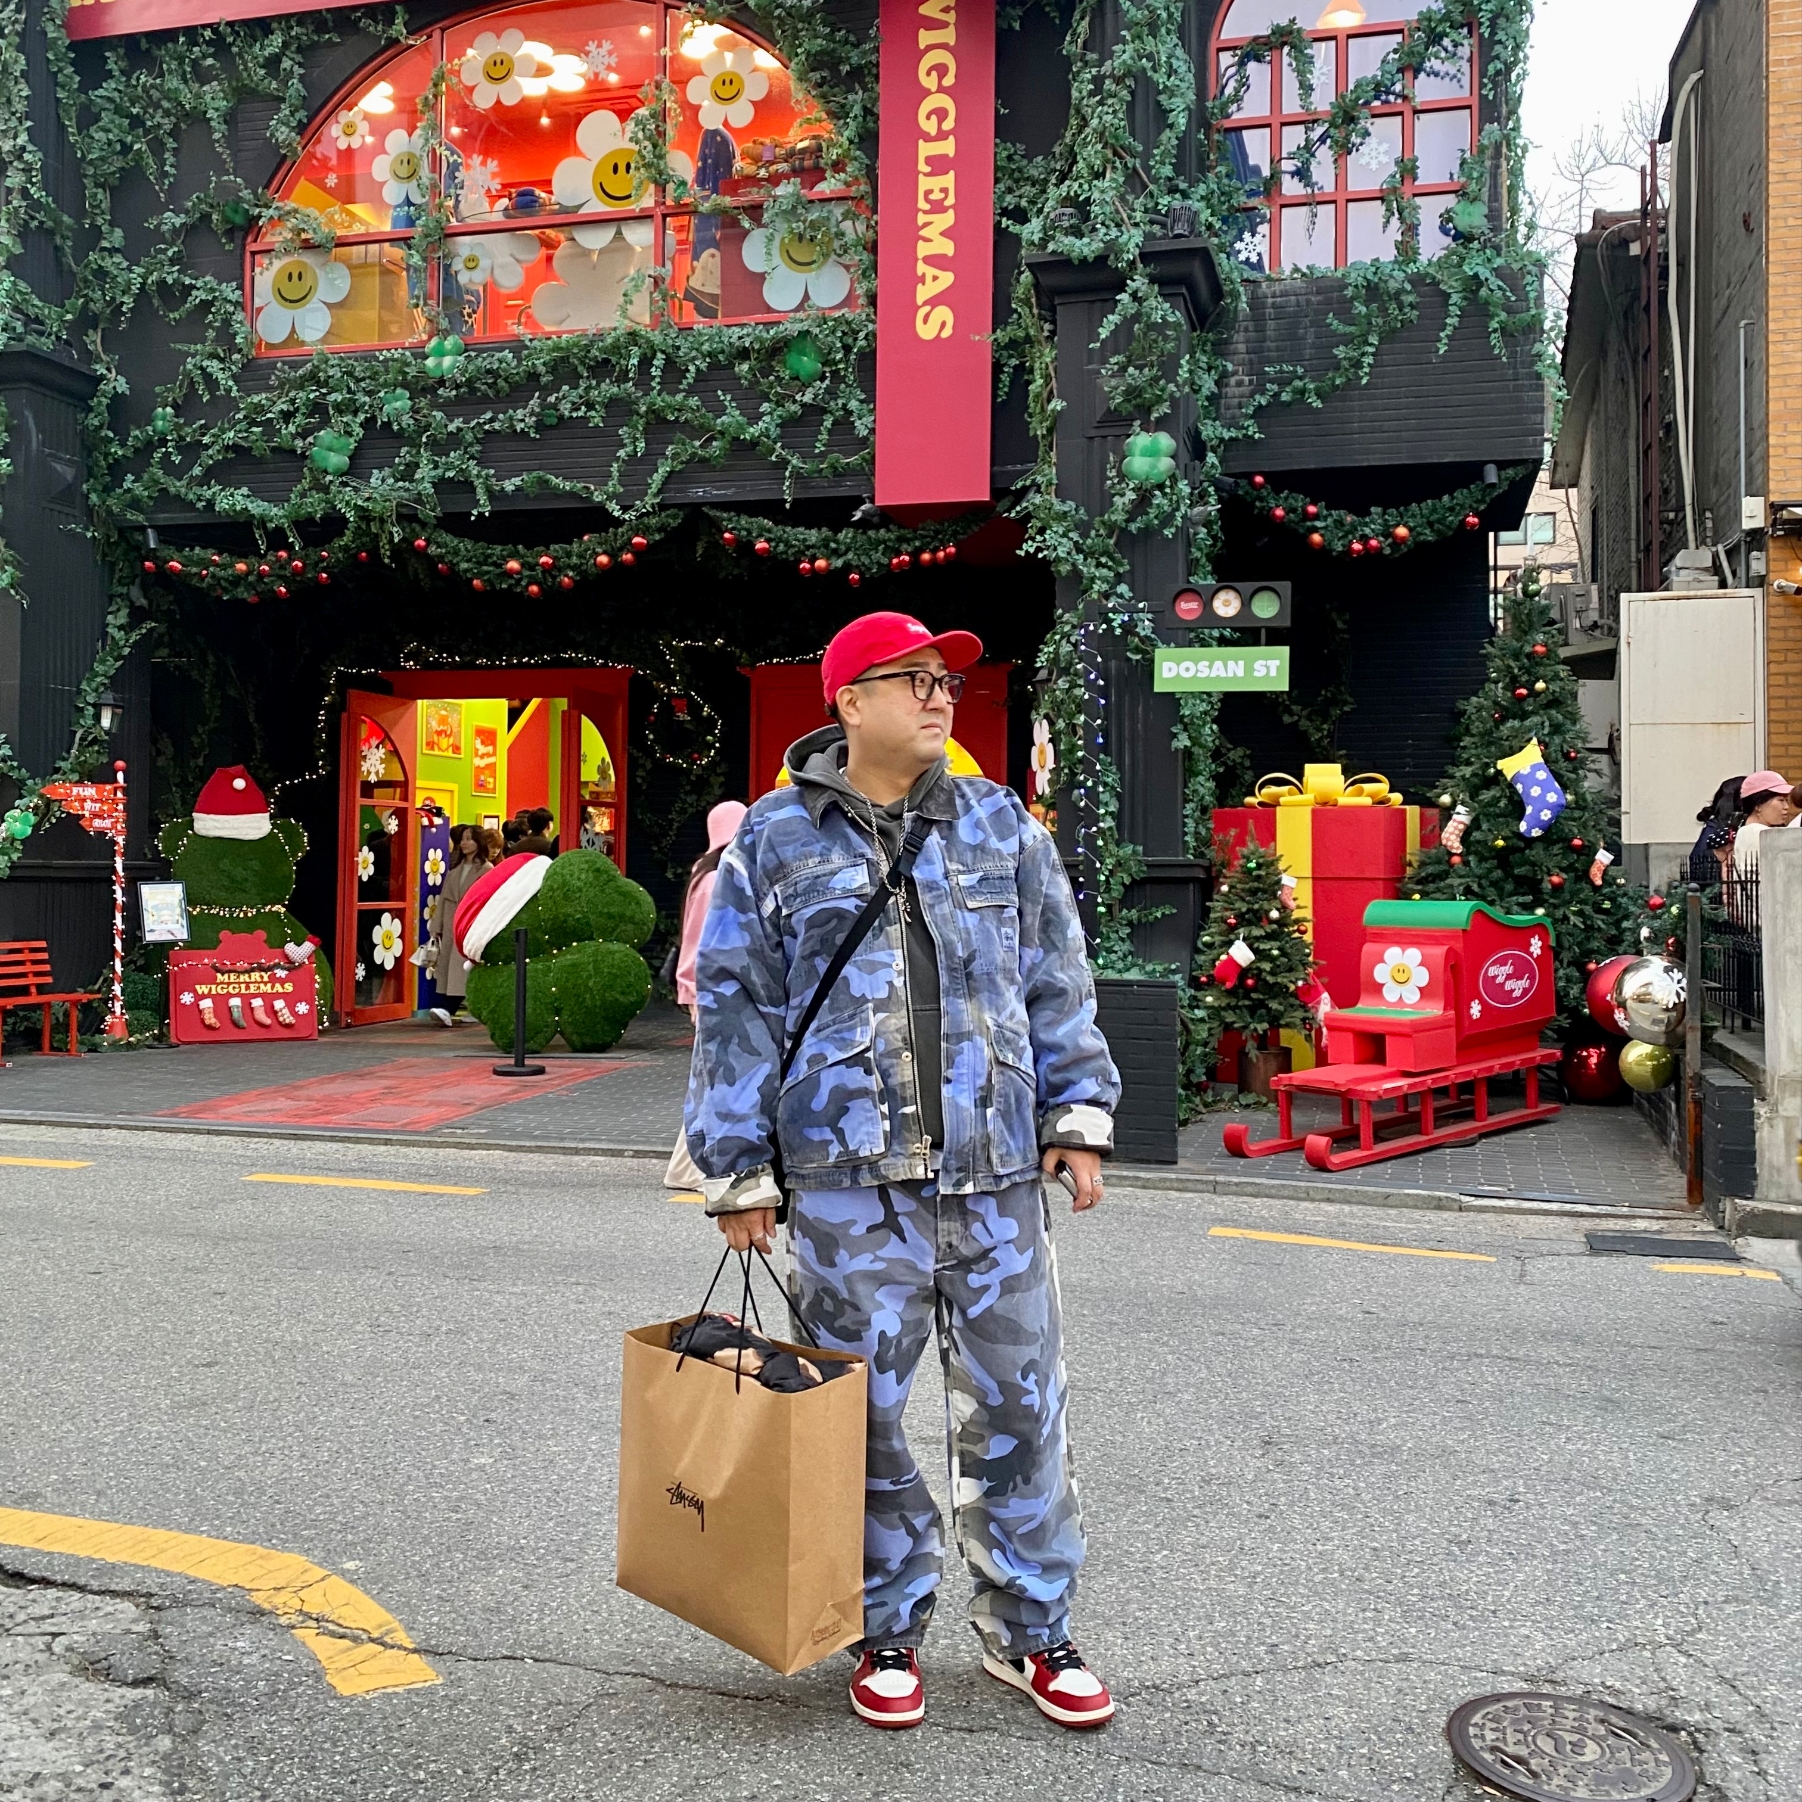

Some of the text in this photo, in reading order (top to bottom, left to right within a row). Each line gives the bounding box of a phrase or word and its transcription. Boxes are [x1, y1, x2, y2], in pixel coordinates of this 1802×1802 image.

[1162, 660, 1280, 678] DOSAN ST
[72, 787, 96, 796] FUN
[83, 802, 102, 812] WIT
[216, 972, 272, 983] MERRY
[195, 983, 293, 995] WIGGLEMAS
